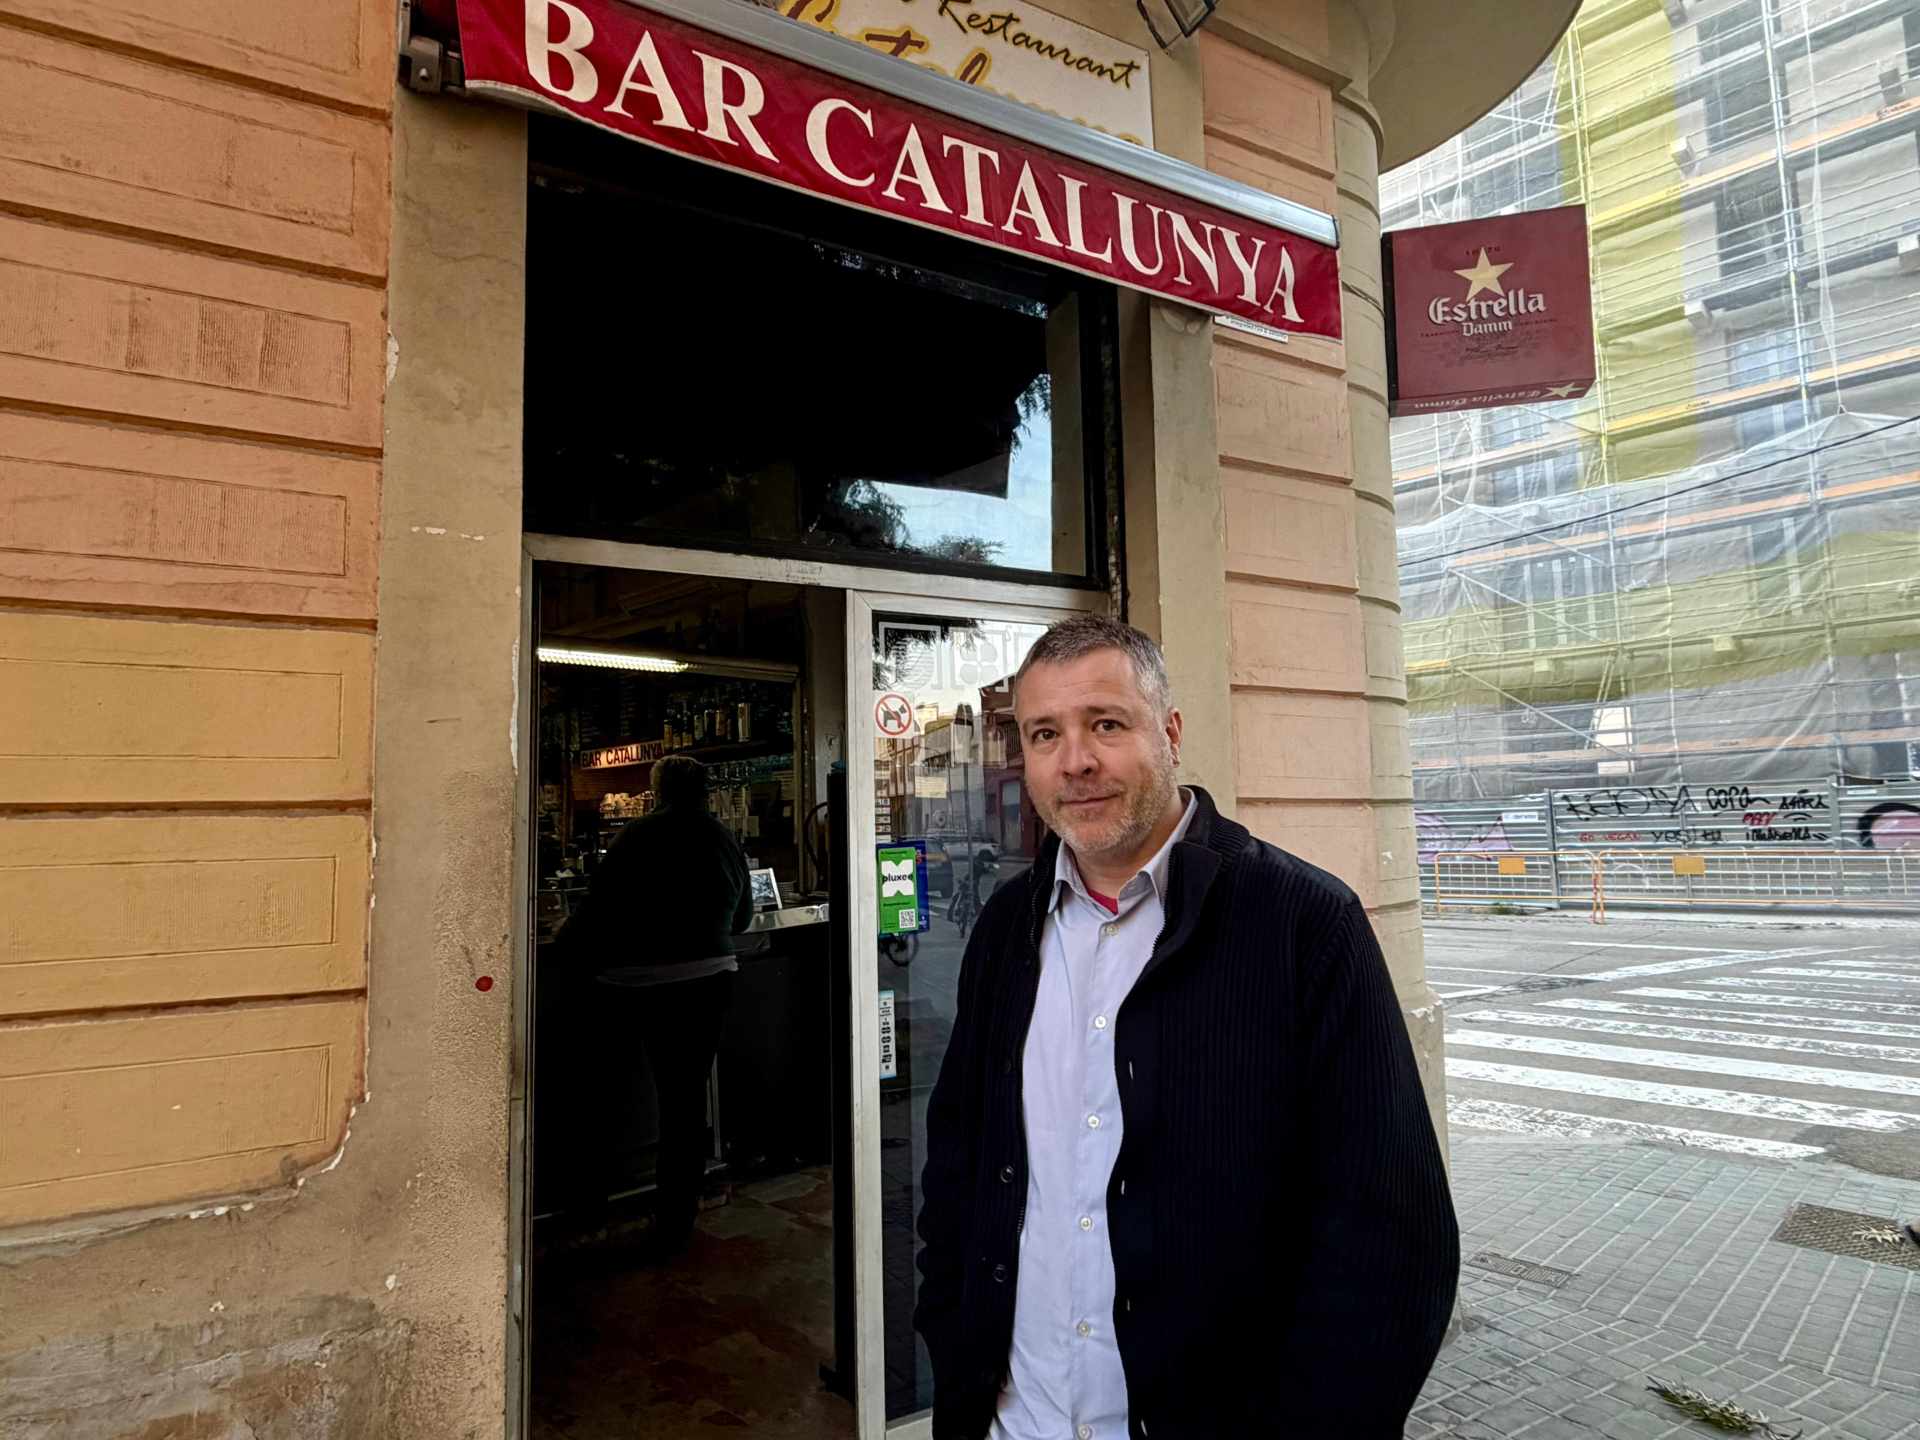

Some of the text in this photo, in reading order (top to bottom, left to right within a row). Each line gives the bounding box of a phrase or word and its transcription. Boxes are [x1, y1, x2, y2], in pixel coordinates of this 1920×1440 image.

[524, 0, 780, 163] BAR
[806, 98, 1304, 323] CATALUNYA
[1428, 288, 1546, 325] Estrella
[1462, 320, 1513, 336] Damm
[582, 742, 664, 767] BAR CATALUNYA
[882, 873, 914, 885] pluxee
